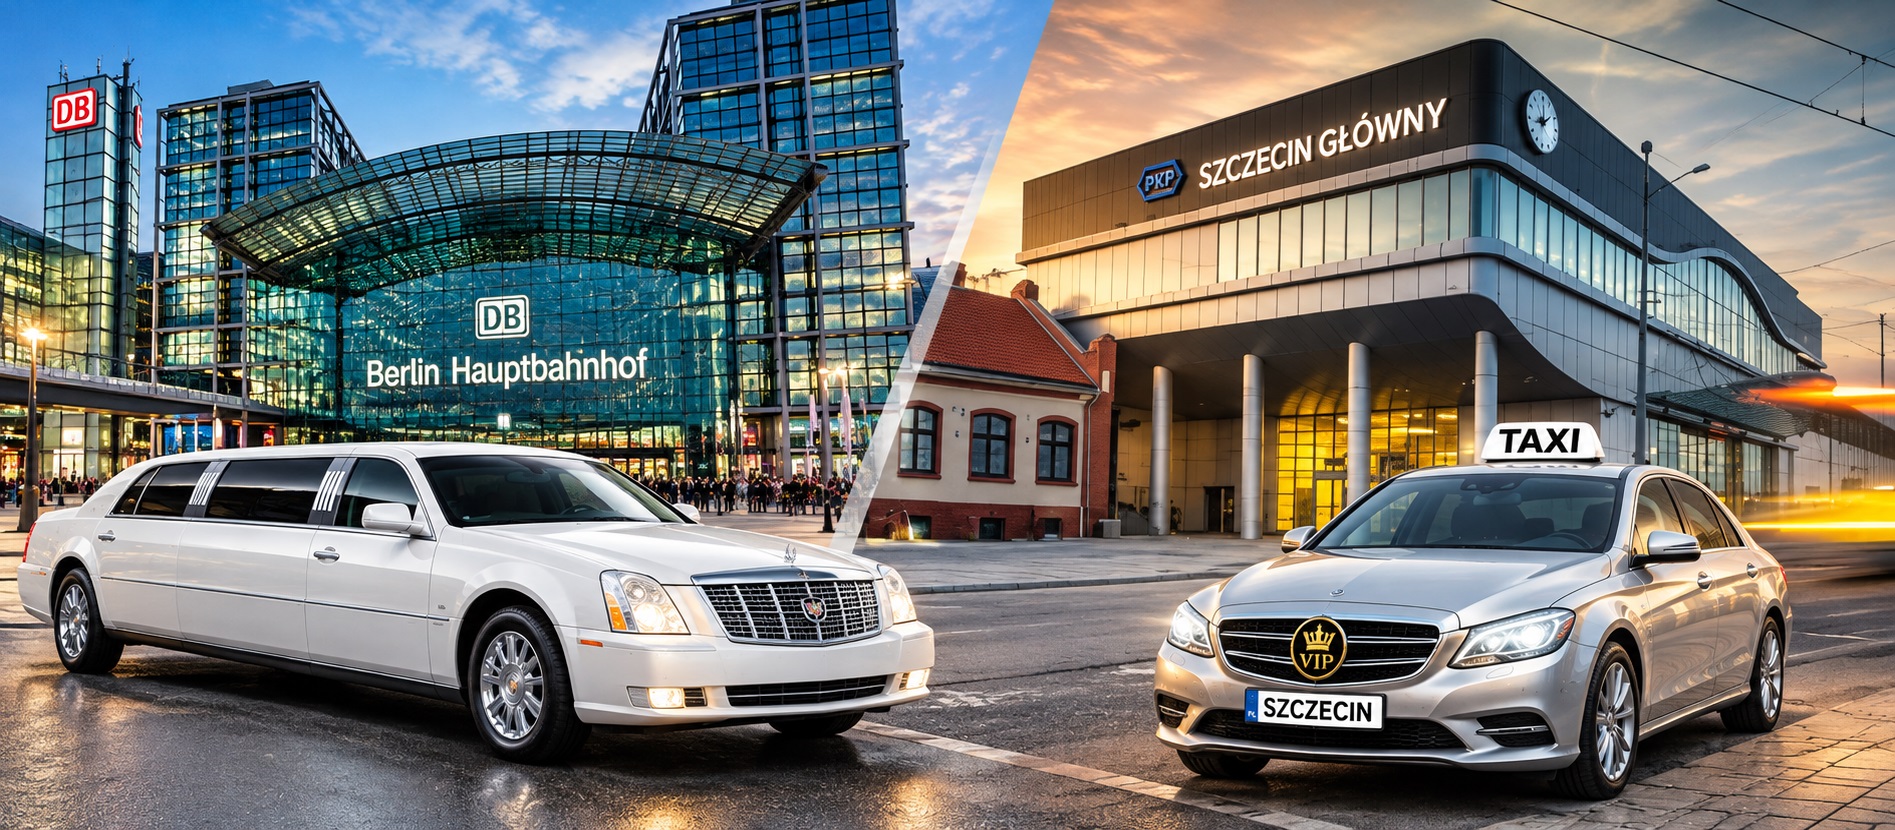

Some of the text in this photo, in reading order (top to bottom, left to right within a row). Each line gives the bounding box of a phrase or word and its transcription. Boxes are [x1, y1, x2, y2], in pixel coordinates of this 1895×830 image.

[57, 96, 89, 124] DB
[1198, 97, 1447, 189] SZCZECIN GŁÓWNY
[1145, 170, 1174, 192] PKP
[484, 304, 520, 331] DB
[366, 346, 649, 390] Berlin Hauptbahnhof
[1499, 428, 1581, 454] TAXI
[1299, 653, 1334, 670] VIP
[1263, 697, 1372, 722] SZCZECIN
